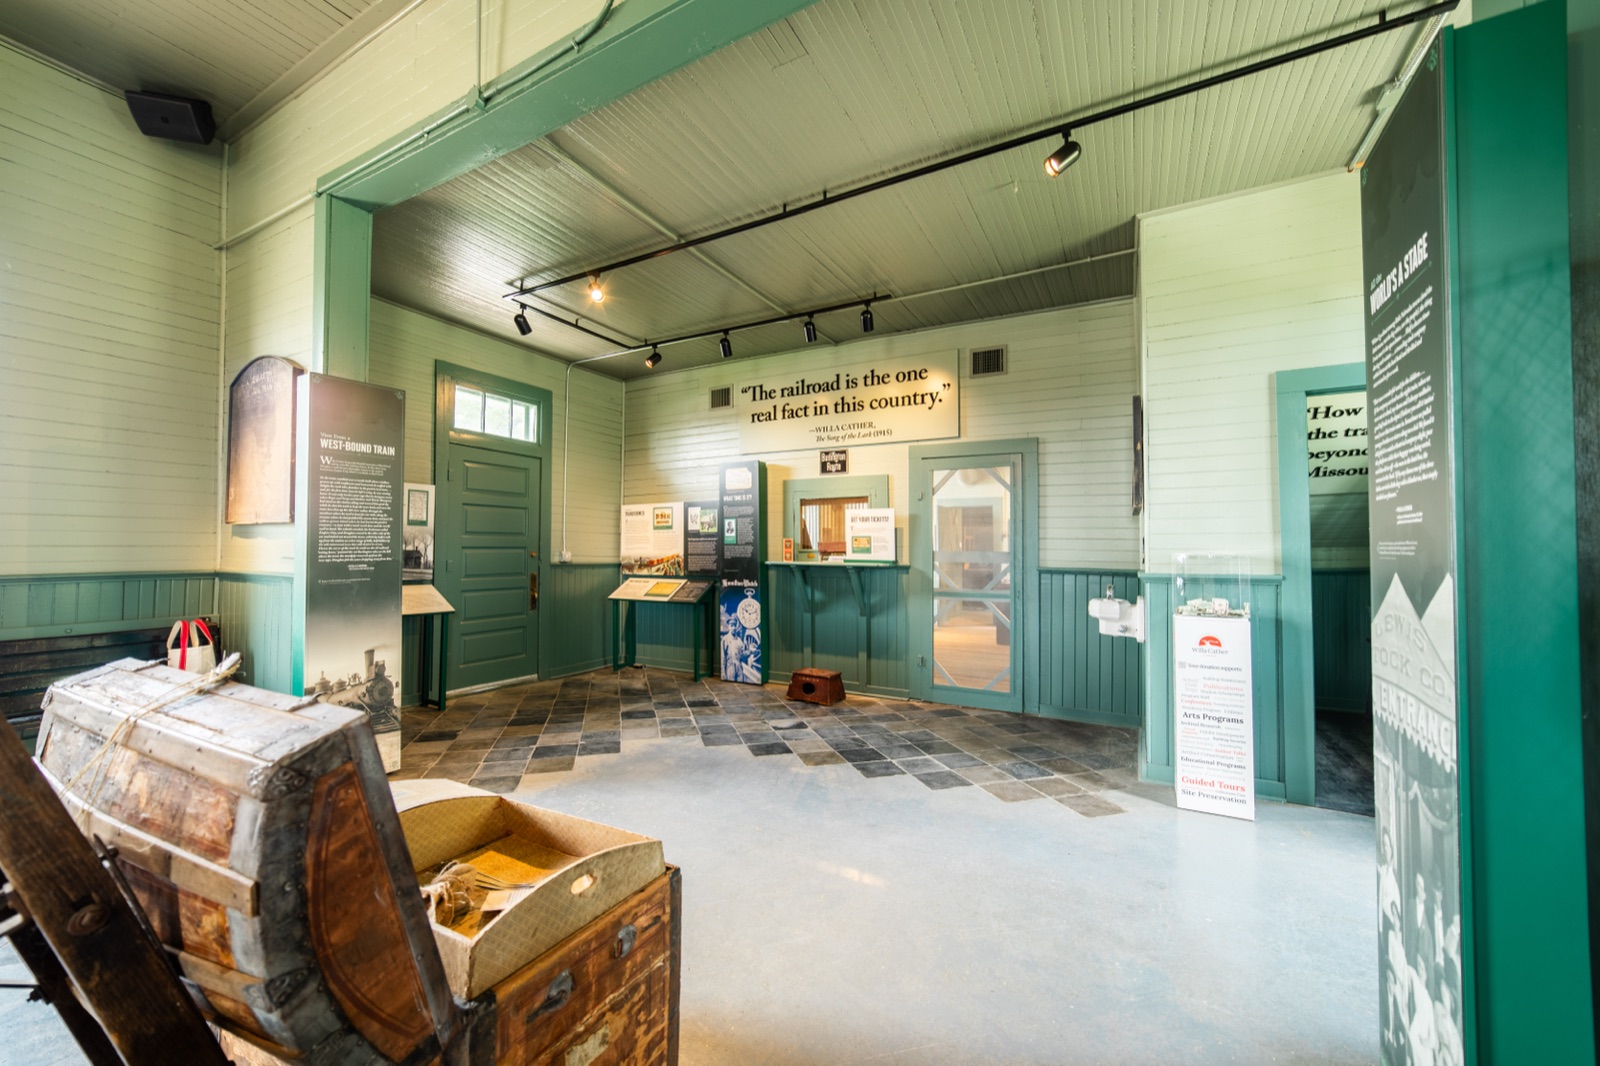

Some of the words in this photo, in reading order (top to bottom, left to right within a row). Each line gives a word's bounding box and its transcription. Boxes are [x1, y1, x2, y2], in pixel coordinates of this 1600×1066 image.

[1370, 266, 1397, 315] WORLD'S
[1397, 261, 1404, 288] A
[1404, 231, 1428, 280] STAGE
[741, 383, 776, 402] “The
[780, 373, 840, 398] railroad
[845, 373, 858, 389] is
[863, 369, 891, 387] the
[895, 367, 928, 383] one
[751, 407, 777, 423] real
[781, 403, 809, 420] fact
[813, 401, 829, 416] in
[834, 396, 864, 414] this
[869, 383, 951, 410] country.”
[841, 421, 876, 431] CATHER,
[816, 433, 825, 442] The
[827, 433, 840, 442] Song
[840, 432, 848, 442] of
[857, 431, 873, 439] Lark
[873, 429, 892, 437] (1915)
[1308, 427, 1338, 440] the
[320, 438, 372, 454] WEST-BOUND
[373, 444, 396, 456] TRAIN
[821, 451, 846, 463] Burlington
[826, 461, 841, 473] Route
[1183, 711, 1200, 719] Arts
[1202, 713, 1244, 724] Programs
[1180, 756, 1215, 766] Educational
[1216, 760, 1246, 770] Programs
[1181, 776, 1215, 787] Guided
[1217, 780, 1246, 792] Tours
[1181, 789, 1197, 797] Site
[1198, 790, 1247, 805] Preservation
